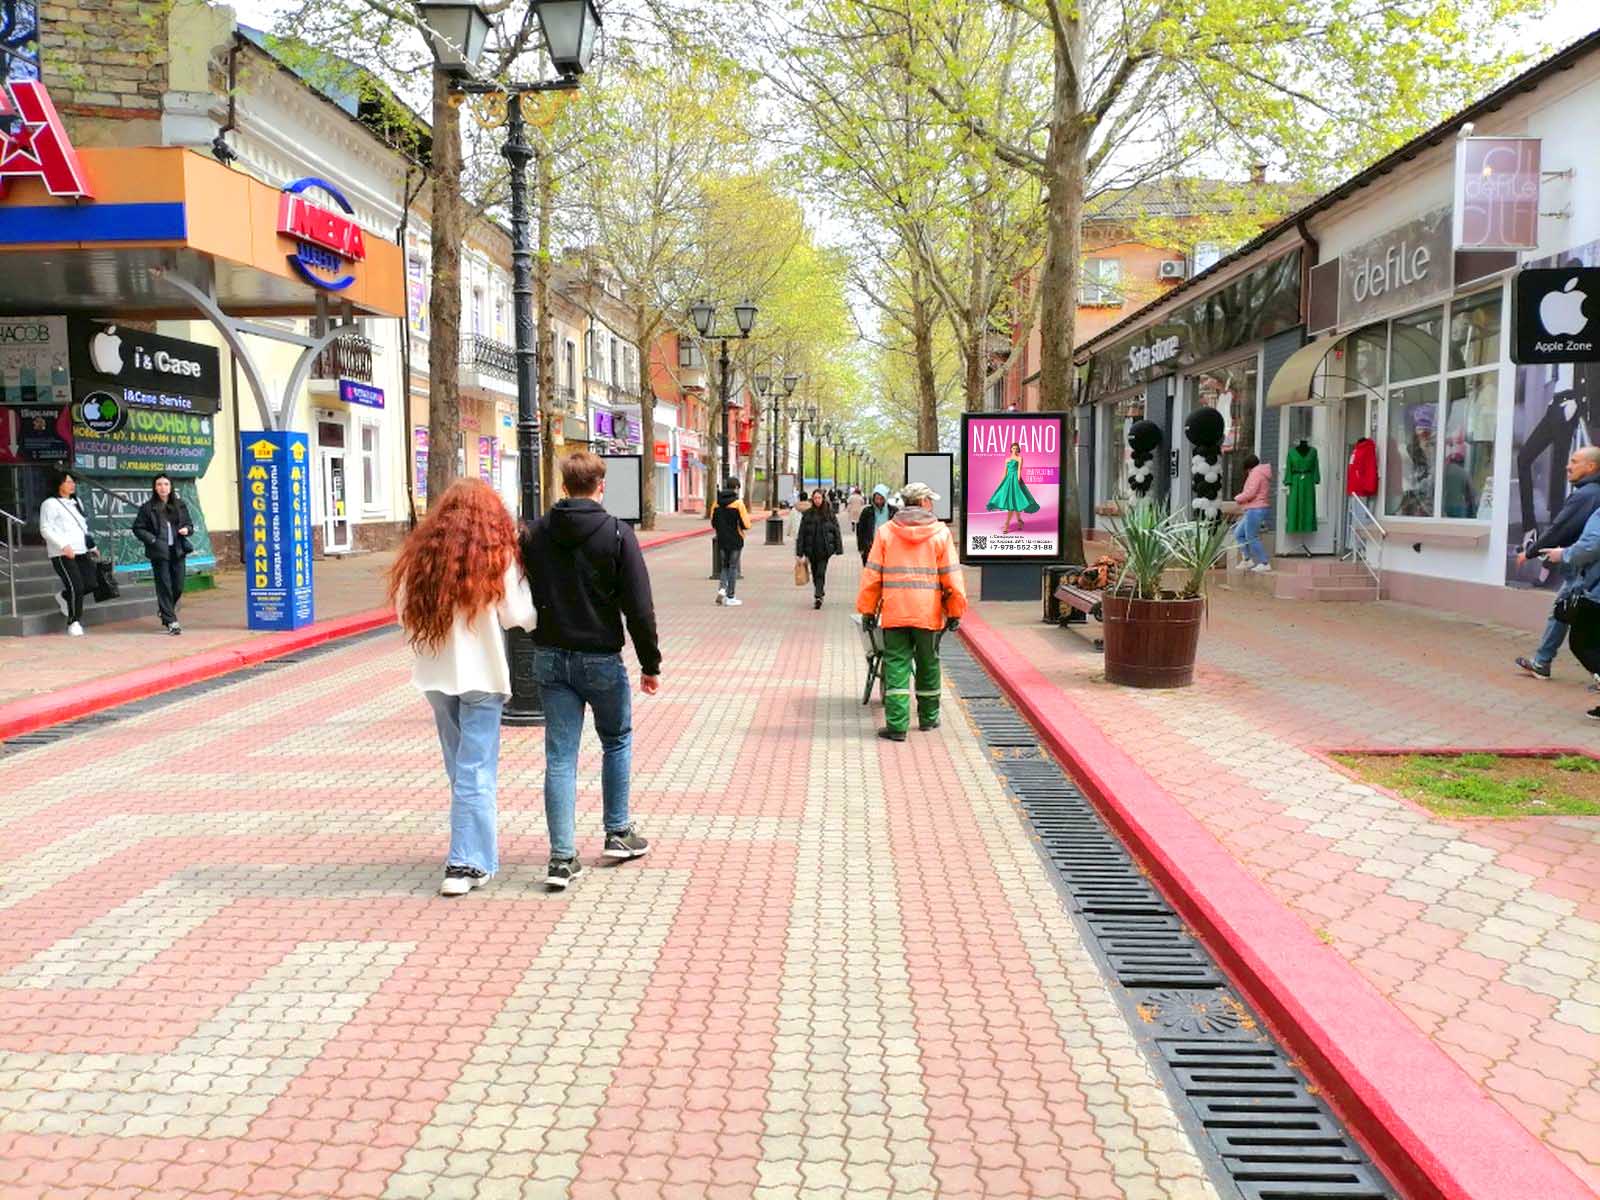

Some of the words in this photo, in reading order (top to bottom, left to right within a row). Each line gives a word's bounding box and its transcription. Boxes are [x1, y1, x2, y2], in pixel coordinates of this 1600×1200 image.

[1354, 241, 1430, 302] defile
[1535, 341, 1564, 352] Apple
[1566, 340, 1593, 351] Zone
[154, 351, 201, 378] Case
[159, 395, 192, 408] Service
[973, 424, 1056, 454] NAVIANO
